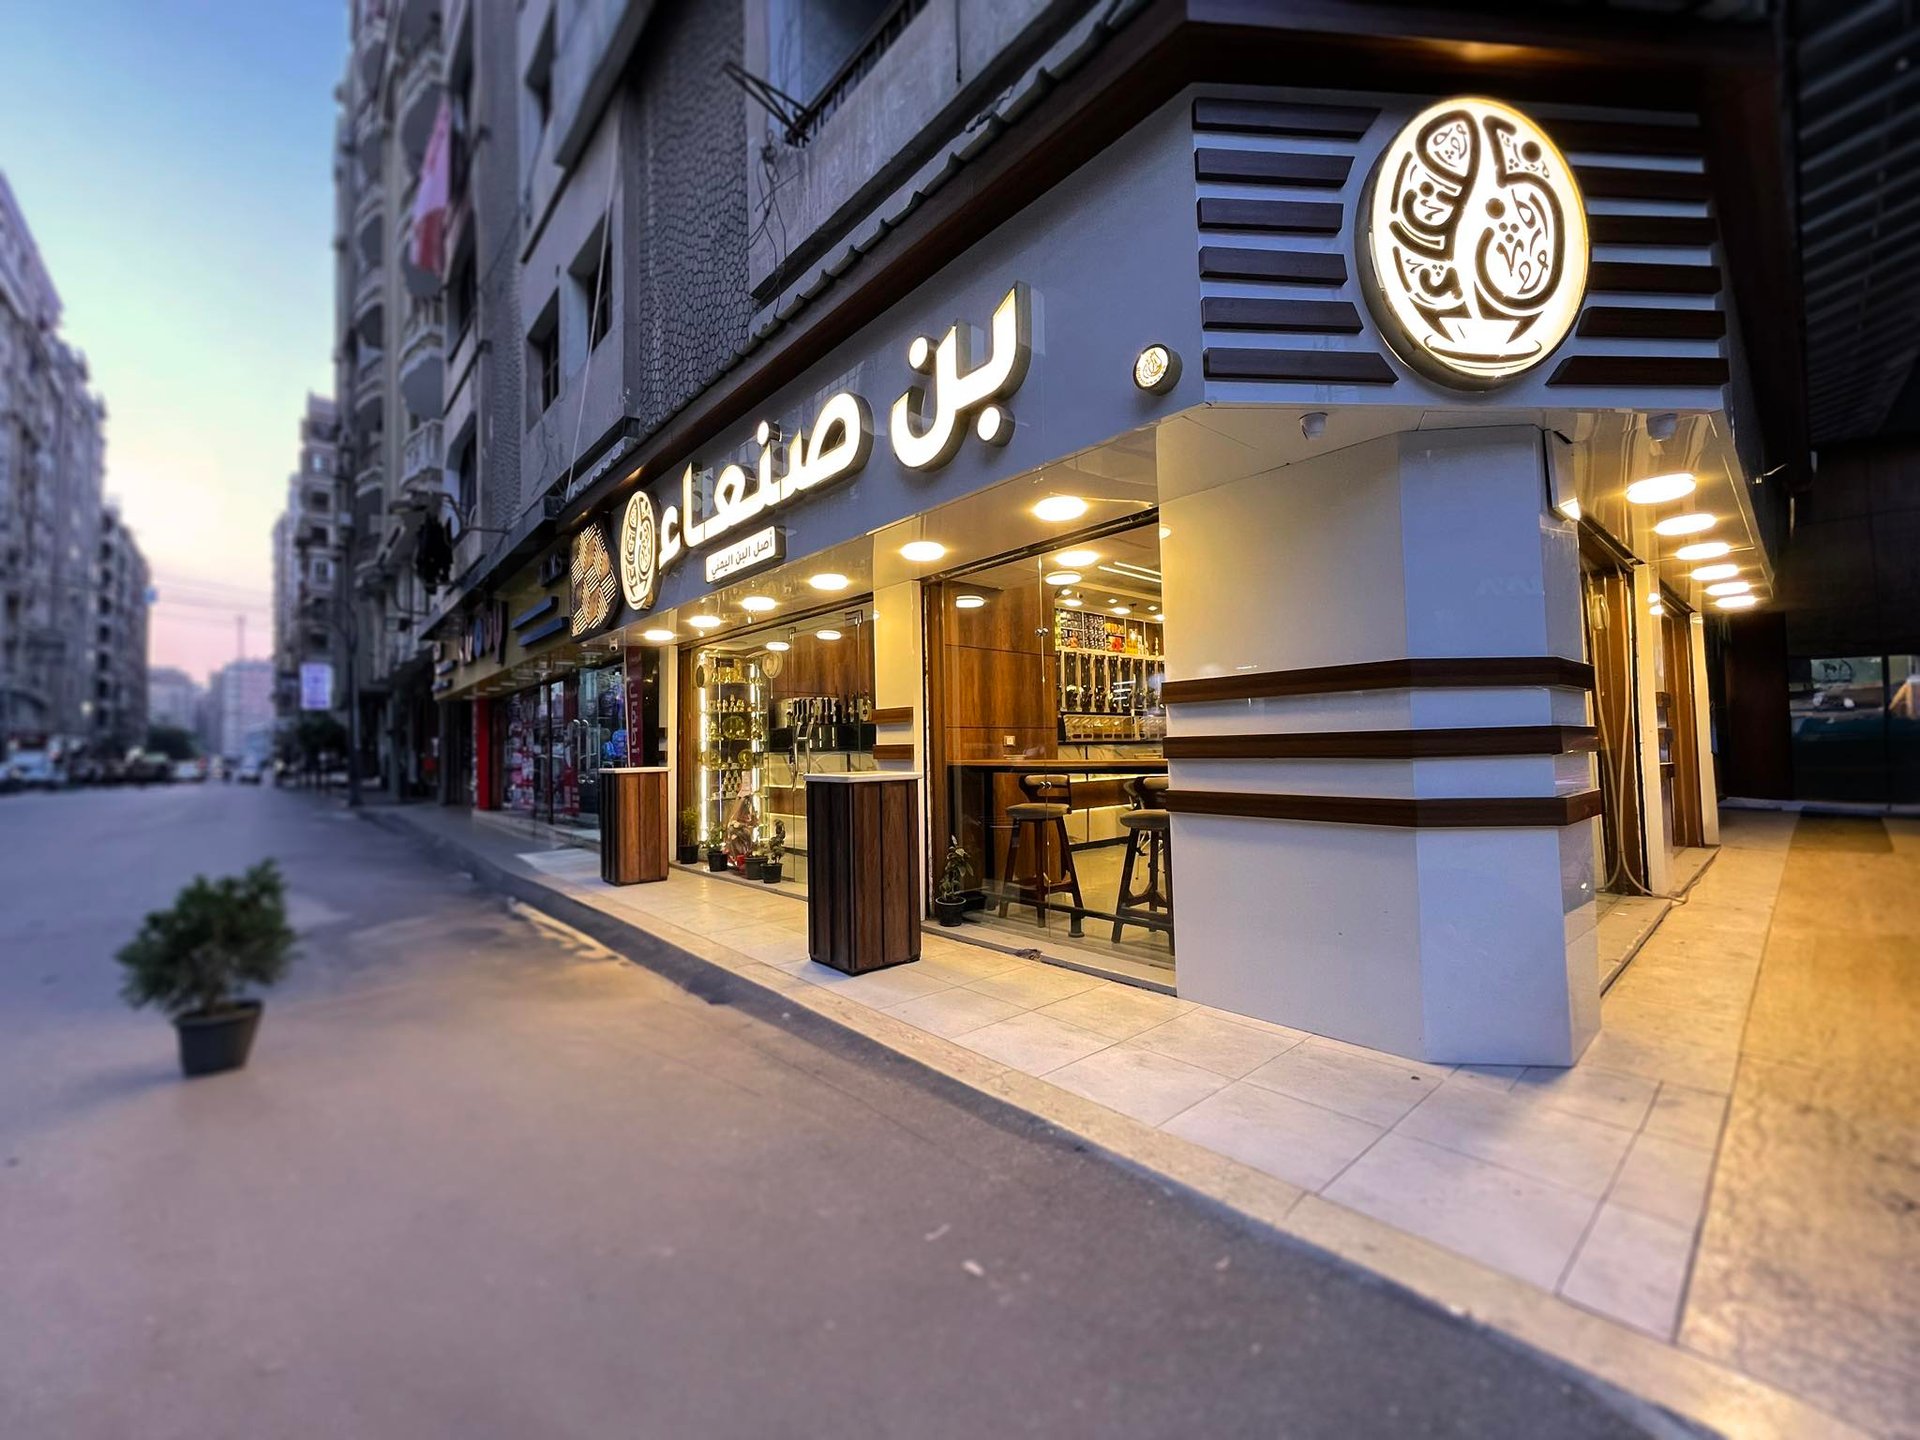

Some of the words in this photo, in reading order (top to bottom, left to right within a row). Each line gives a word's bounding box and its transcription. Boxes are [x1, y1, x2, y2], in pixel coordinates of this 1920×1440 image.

[892, 284, 1022, 469] بن
[659, 392, 866, 570] صنعاء
[735, 546, 751, 565] البن
